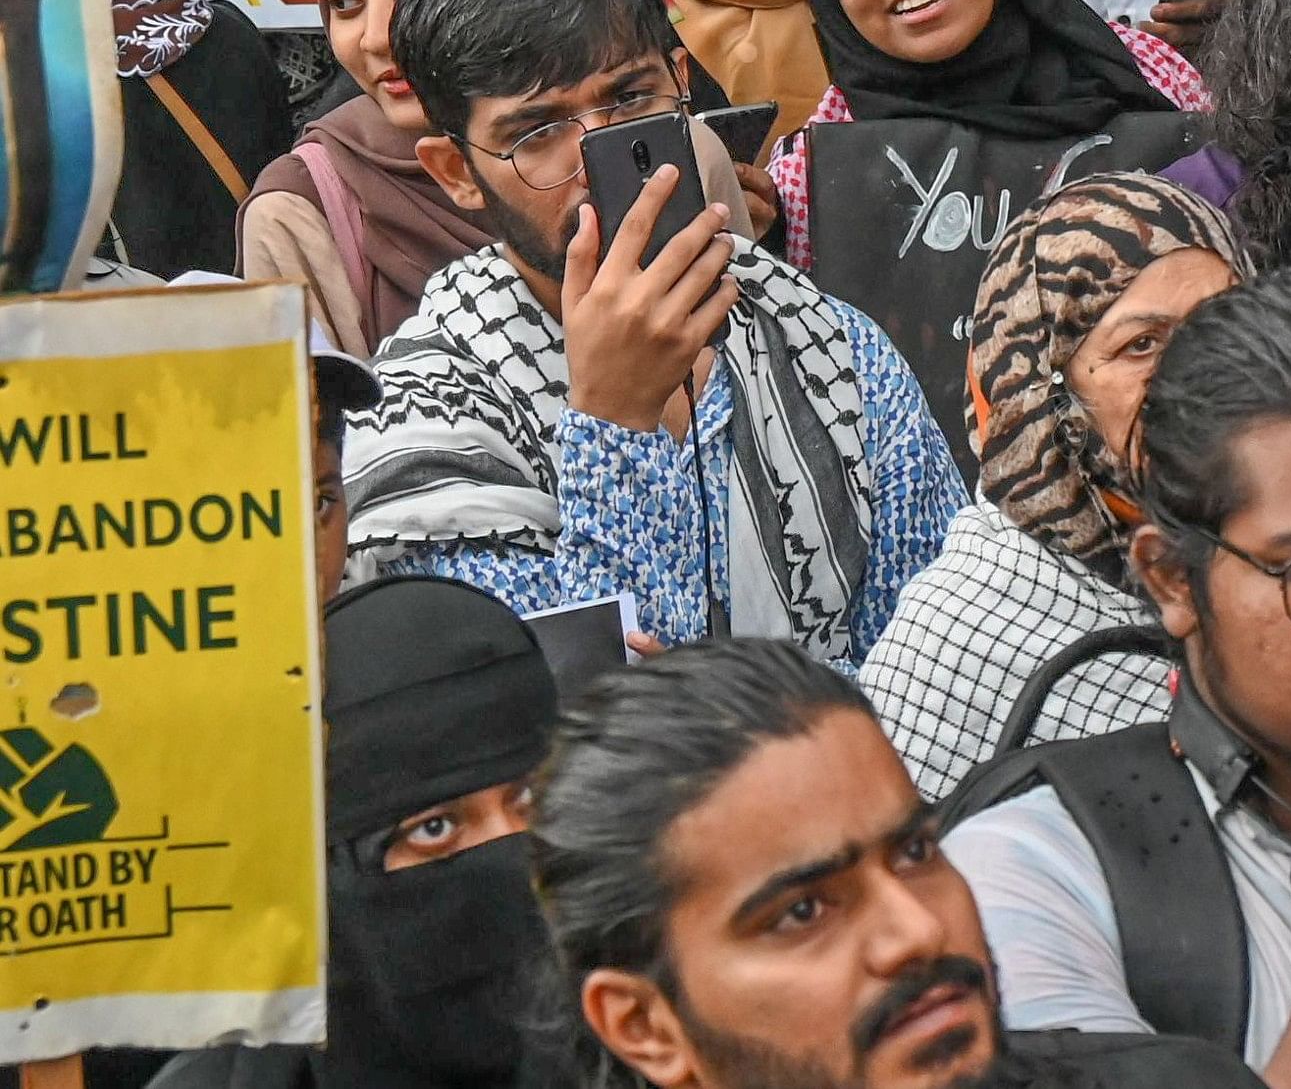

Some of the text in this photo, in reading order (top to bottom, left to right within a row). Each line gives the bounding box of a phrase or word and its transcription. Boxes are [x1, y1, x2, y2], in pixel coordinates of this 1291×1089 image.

[0, 412, 148, 468] WILL
[0, 489, 282, 557] BANDON
[109, 847, 158, 885] BY
[28, 894, 127, 938] OATH
